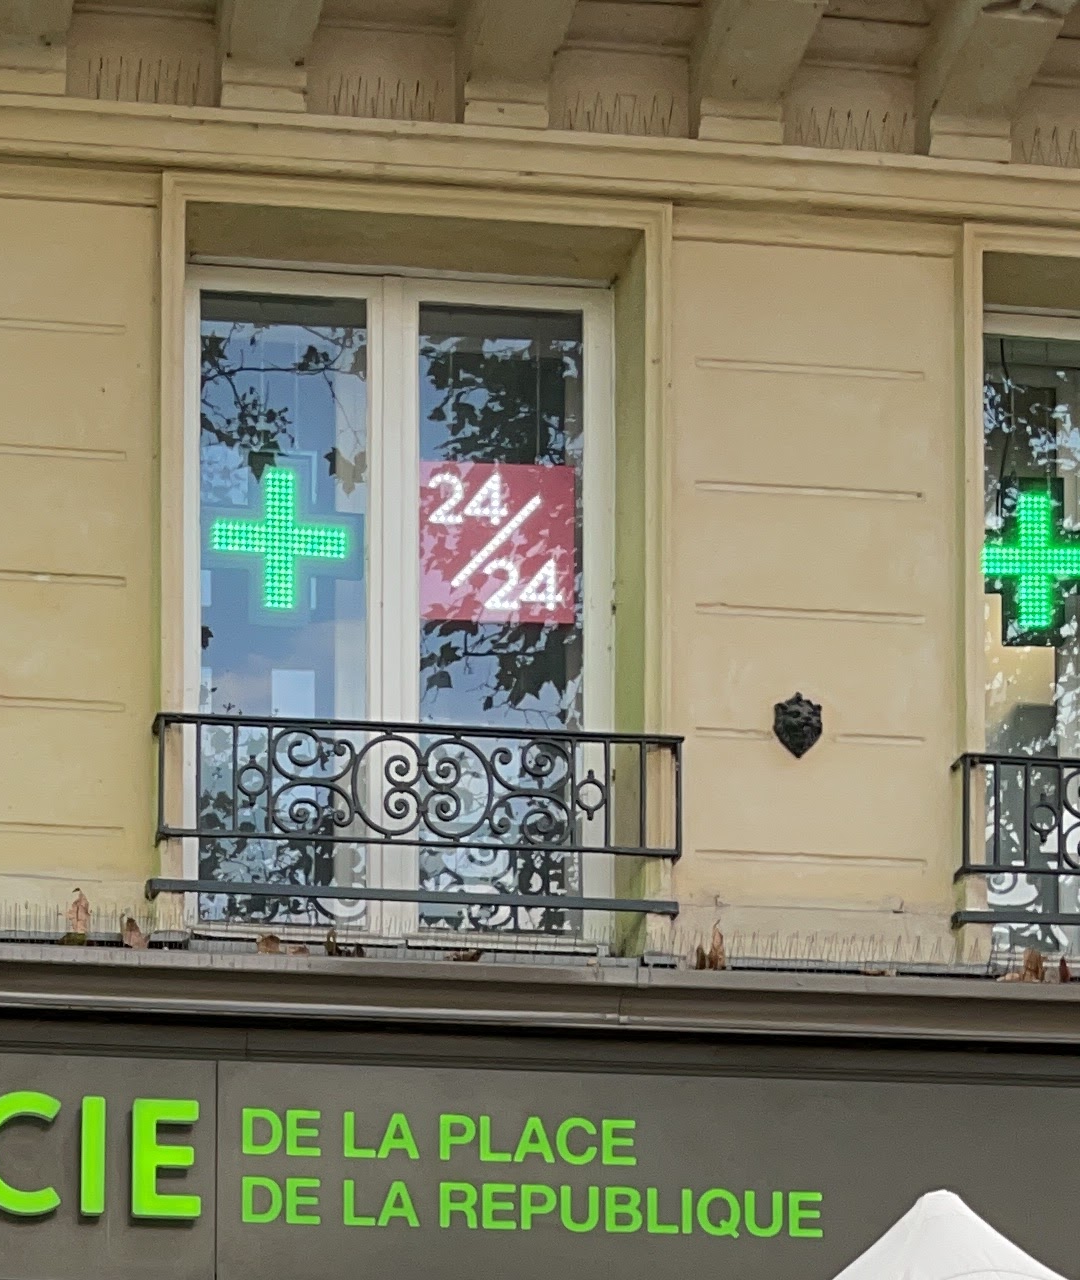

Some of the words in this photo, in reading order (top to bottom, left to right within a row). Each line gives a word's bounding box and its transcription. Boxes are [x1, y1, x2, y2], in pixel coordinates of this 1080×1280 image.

[242, 1107, 321, 1158] DE
[343, 1110, 420, 1160] LA
[439, 1113, 637, 1167] PLACE
[242, 1176, 321, 1226] DE
[343, 1179, 420, 1228] LA
[439, 1181, 824, 1239] REPUBLIQUE
